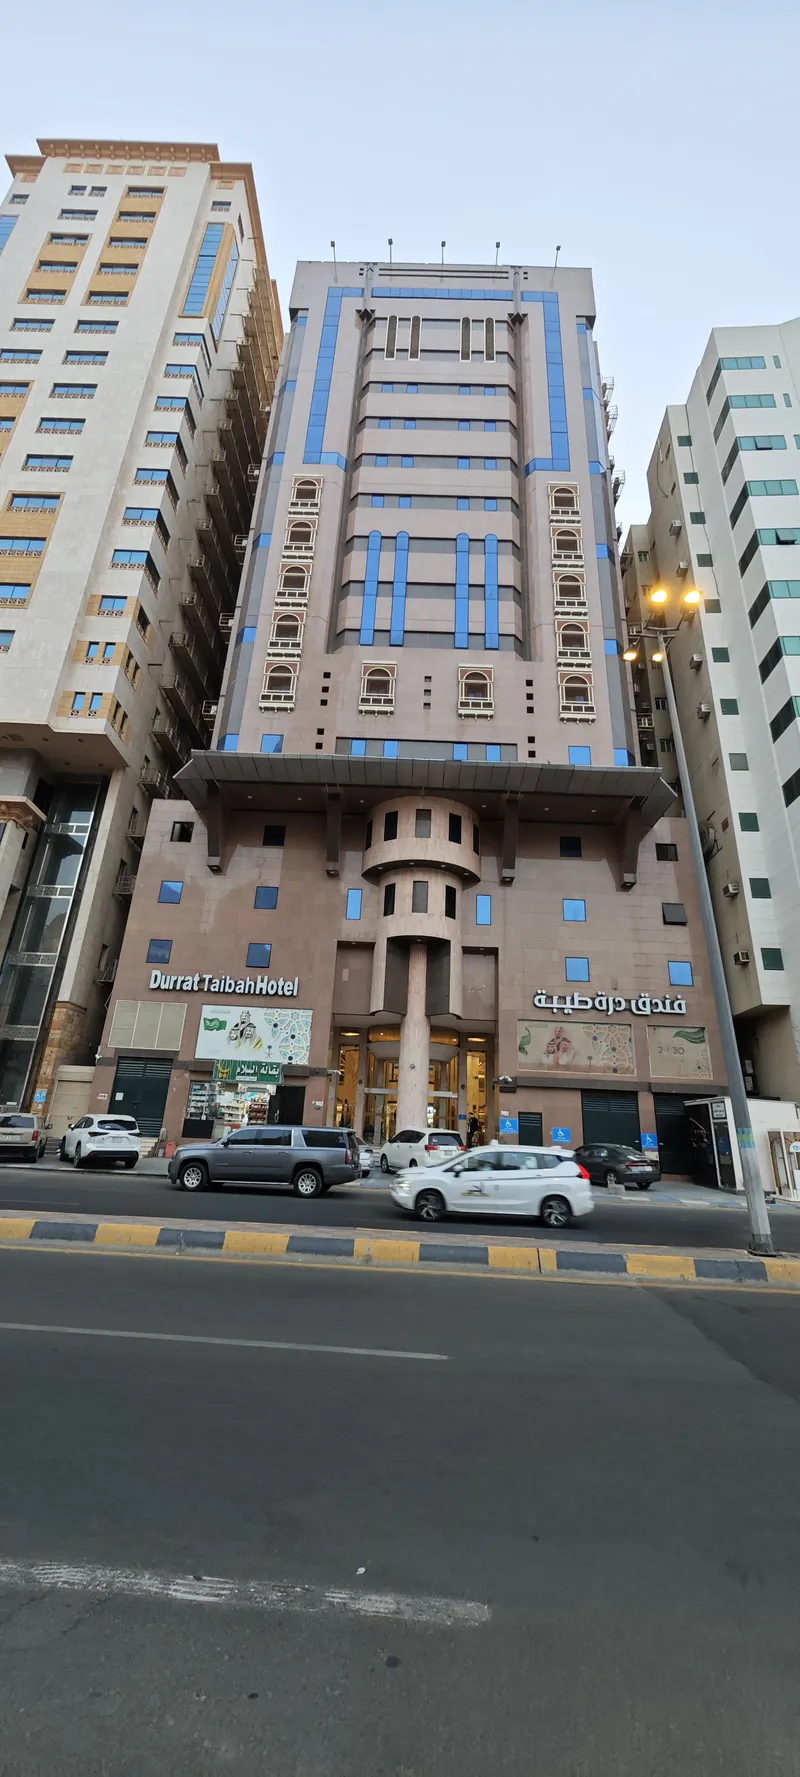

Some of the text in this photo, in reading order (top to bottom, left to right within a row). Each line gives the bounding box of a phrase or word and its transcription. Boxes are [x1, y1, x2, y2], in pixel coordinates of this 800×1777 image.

[149, 969, 299, 996] Durrat Taibah Hotel
[533, 989, 687, 1016] فندق درة طيبة
[657, 1045, 685, 1055] 230
[236, 1062, 280, 1078] بقالة السلام
